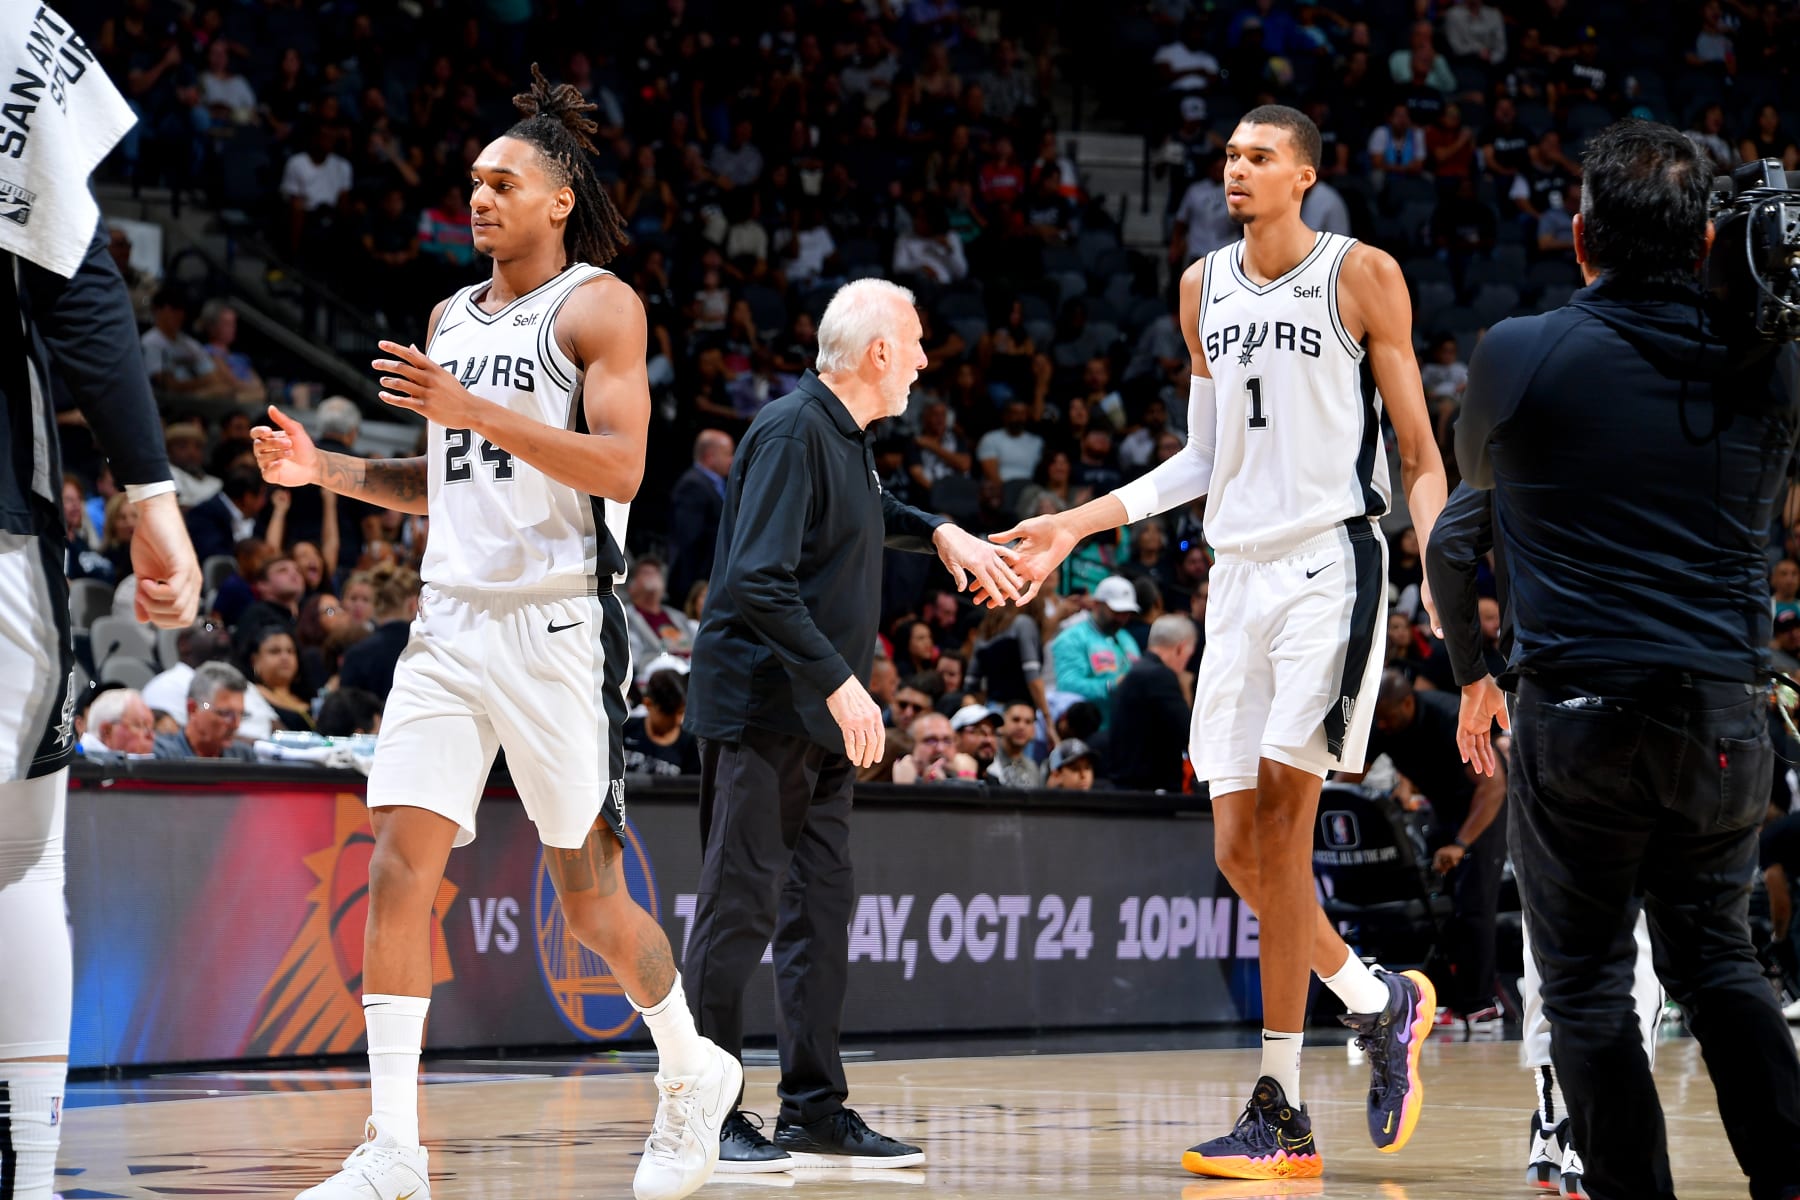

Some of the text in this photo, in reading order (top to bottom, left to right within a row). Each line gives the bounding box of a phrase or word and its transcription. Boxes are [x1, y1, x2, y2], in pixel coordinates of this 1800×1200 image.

[0, 67, 46, 159] SAN
[1293, 285, 1323, 299] Self.
[512, 313, 540, 327] Self.
[1206, 321, 1322, 368] SPURS
[1244, 375, 1268, 430] 1
[445, 427, 514, 484] 24
[469, 897, 520, 954] VS
[928, 893, 1031, 963] OCT
[1034, 895, 1093, 960] 24
[1117, 896, 1230, 961] 10PM
[1235, 898, 1260, 959] E
